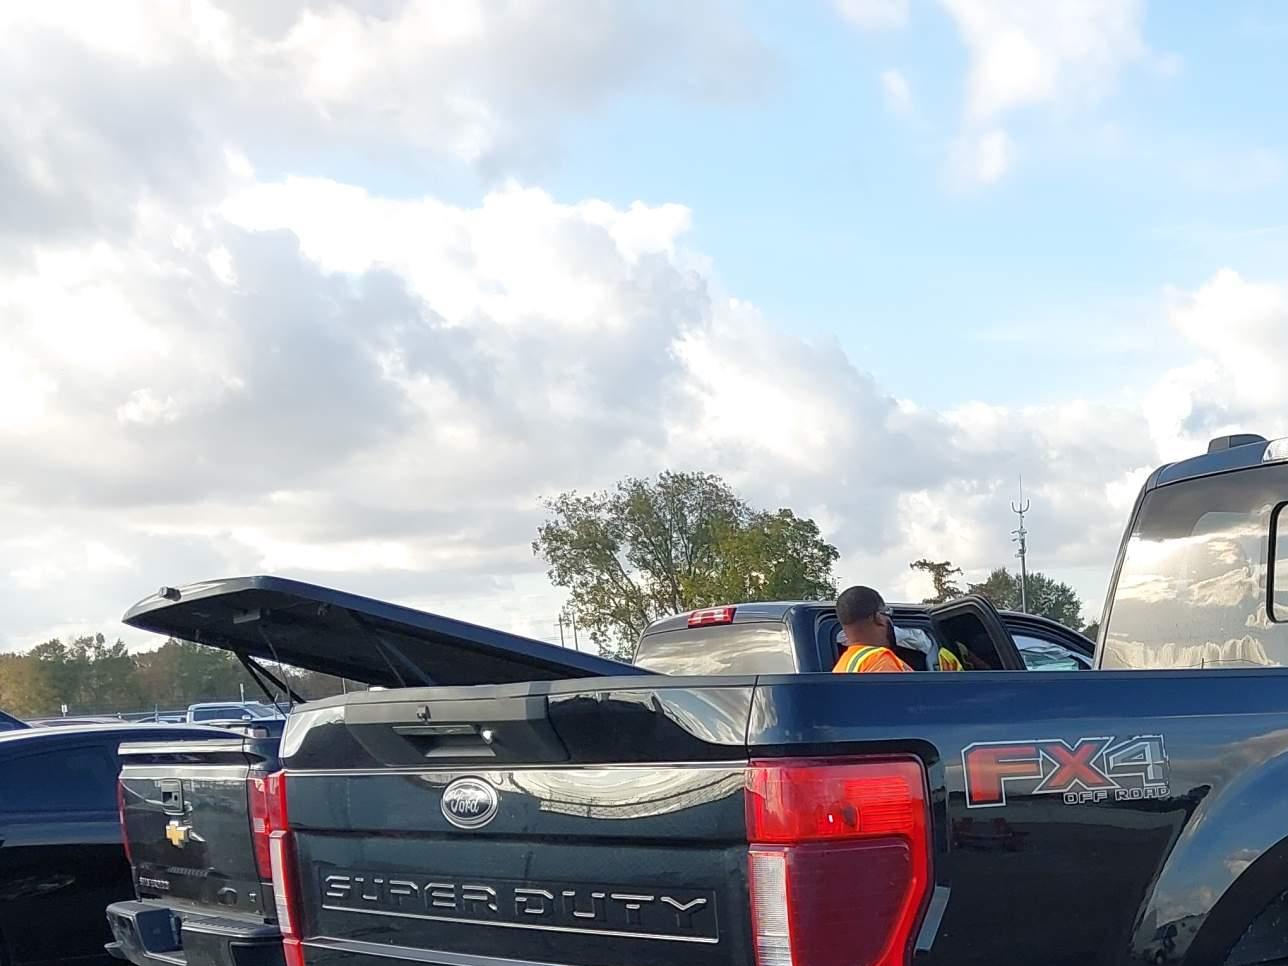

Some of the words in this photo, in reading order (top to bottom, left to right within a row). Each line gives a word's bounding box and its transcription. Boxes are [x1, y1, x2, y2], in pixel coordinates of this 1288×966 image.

[961, 734, 1171, 808] FX4
[1064, 790, 1109, 805] OFF
[1115, 786, 1171, 801] ROAD
[324, 875, 498, 913] SUPER
[514, 887, 708, 928] DUTY
